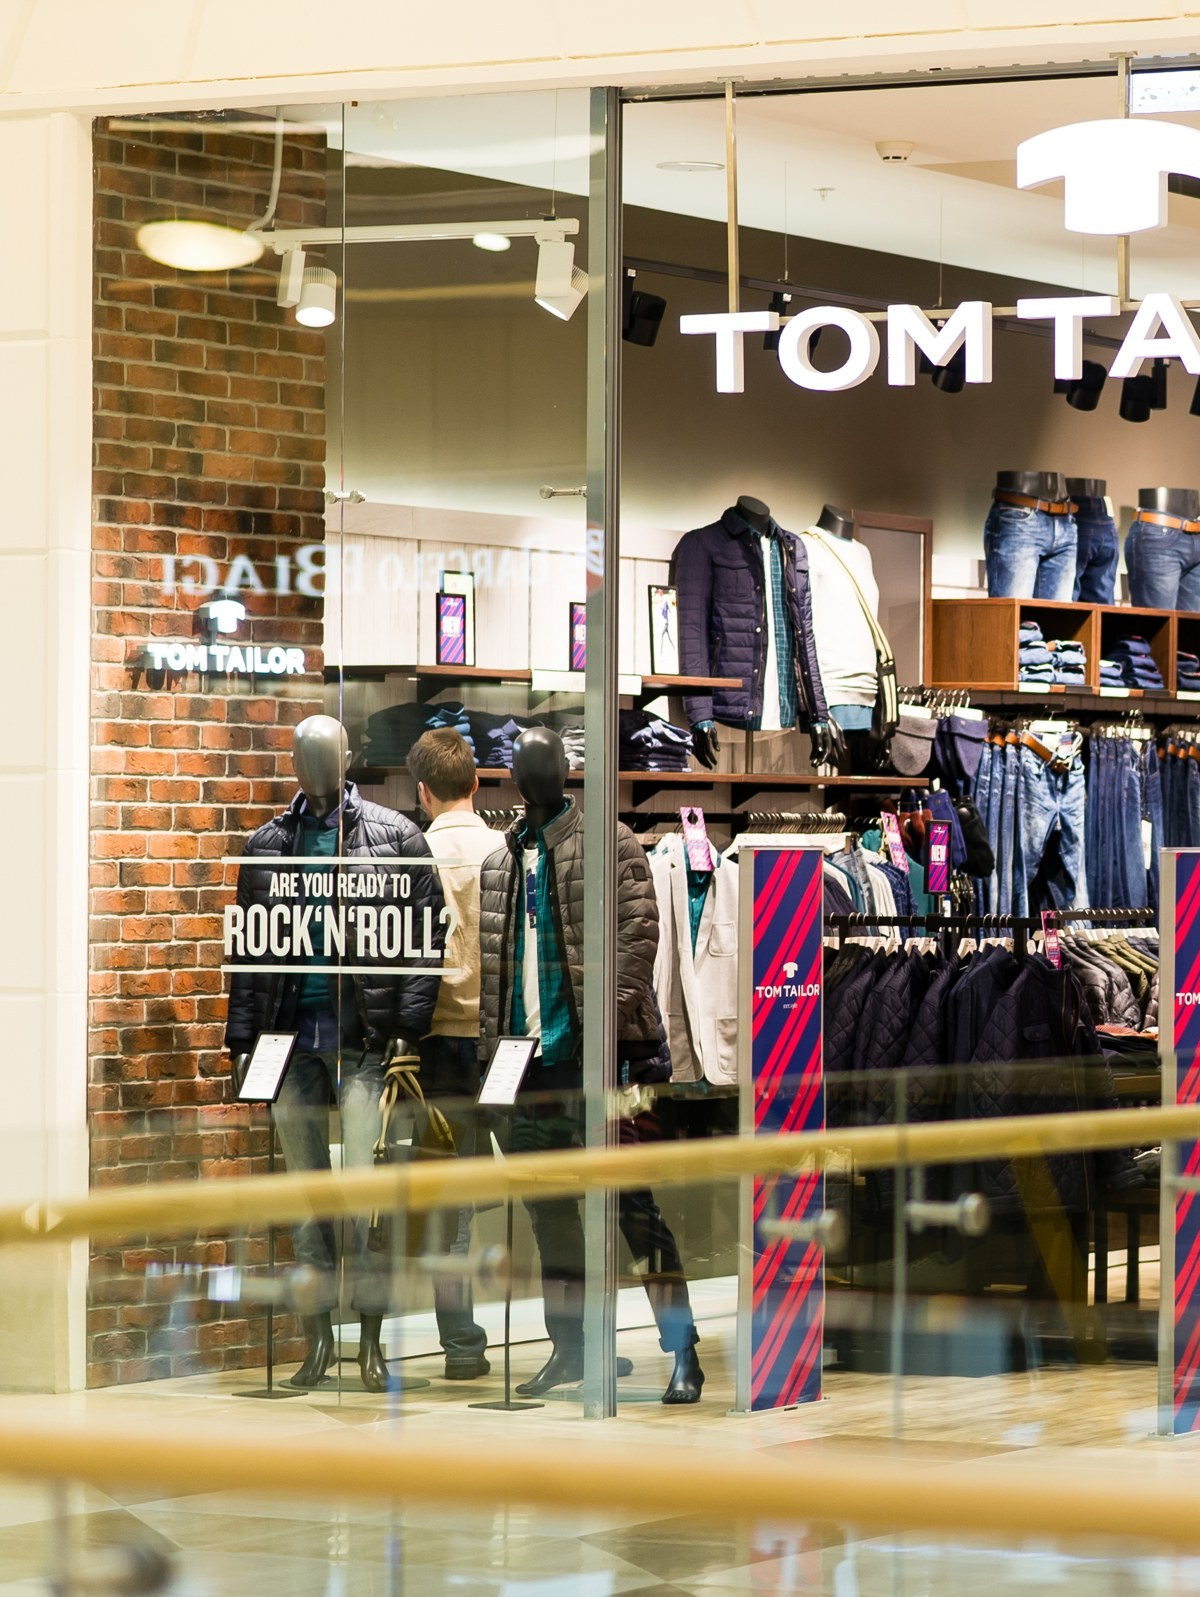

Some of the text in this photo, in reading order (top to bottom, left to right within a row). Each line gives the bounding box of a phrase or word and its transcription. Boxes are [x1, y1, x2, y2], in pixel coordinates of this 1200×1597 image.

[680, 301, 993, 393] TOM
[147, 643, 305, 674] TOM TAILOR
[269, 872, 411, 898] ARE YOU READY TO
[755, 984, 820, 998] TOM TAILOR
[1176, 992, 1200, 1005] TOM
